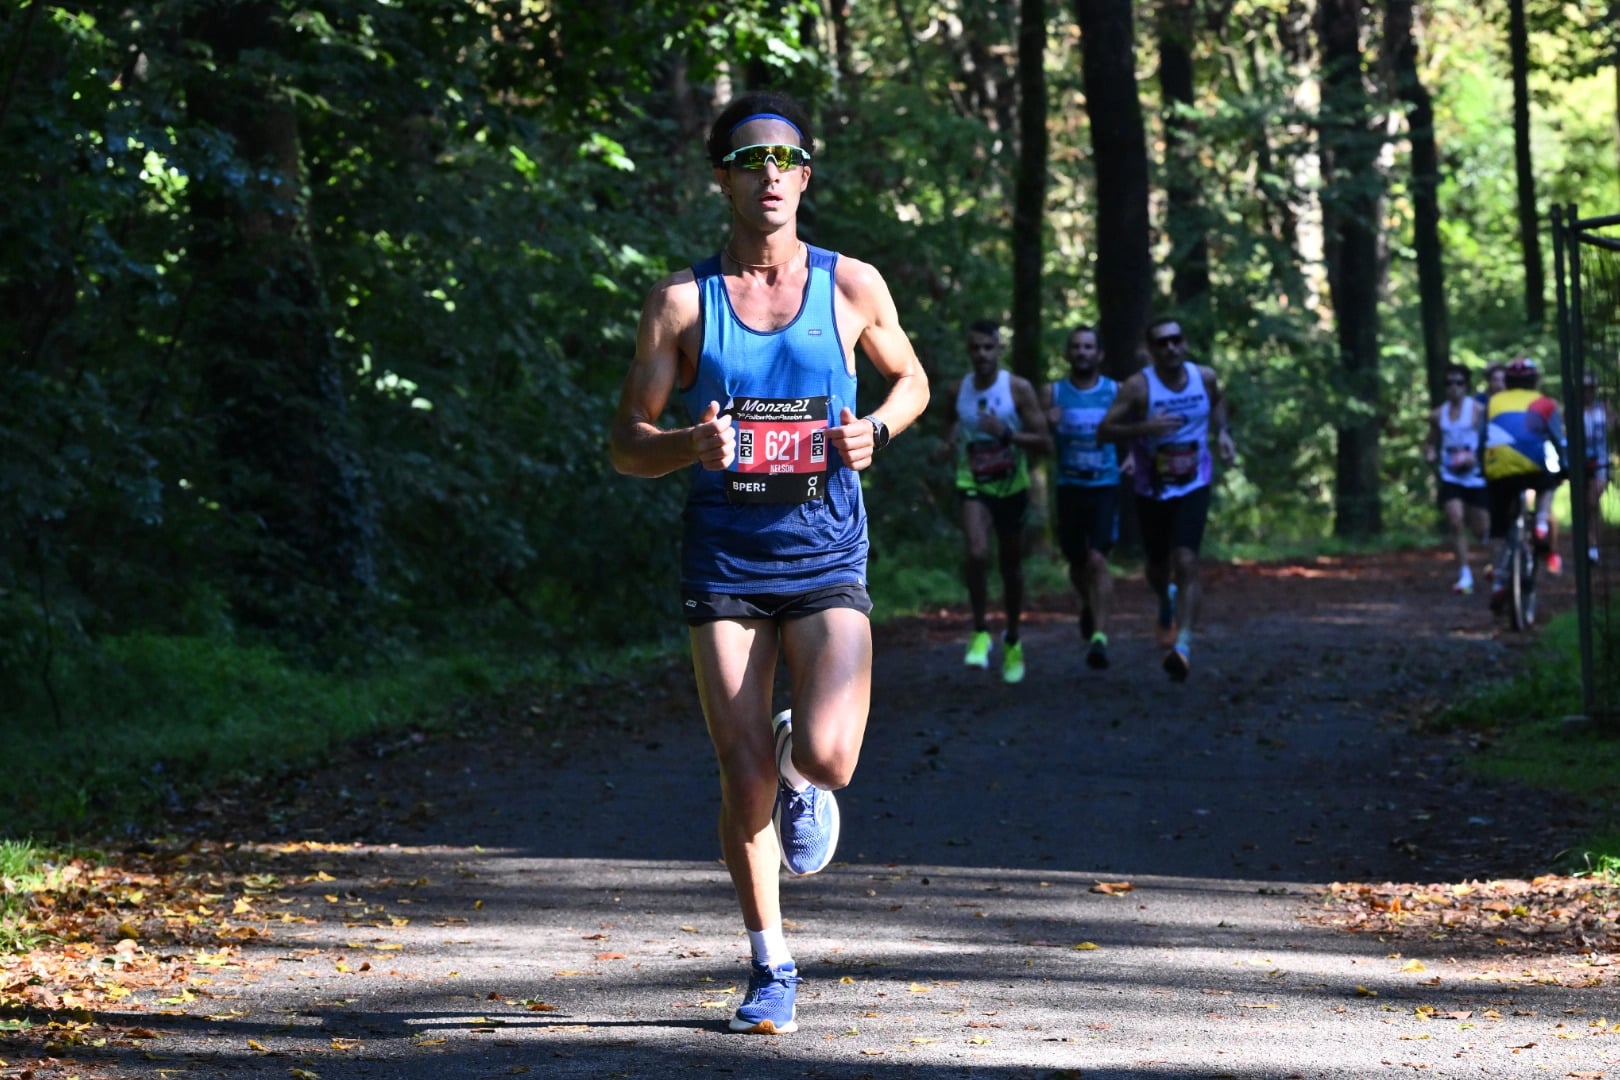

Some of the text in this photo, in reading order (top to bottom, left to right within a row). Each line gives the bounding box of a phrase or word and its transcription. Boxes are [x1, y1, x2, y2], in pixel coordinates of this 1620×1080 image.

[741, 399, 810, 413] Monza21
[765, 430, 800, 461] 621
[770, 464, 795, 473] NELSON
